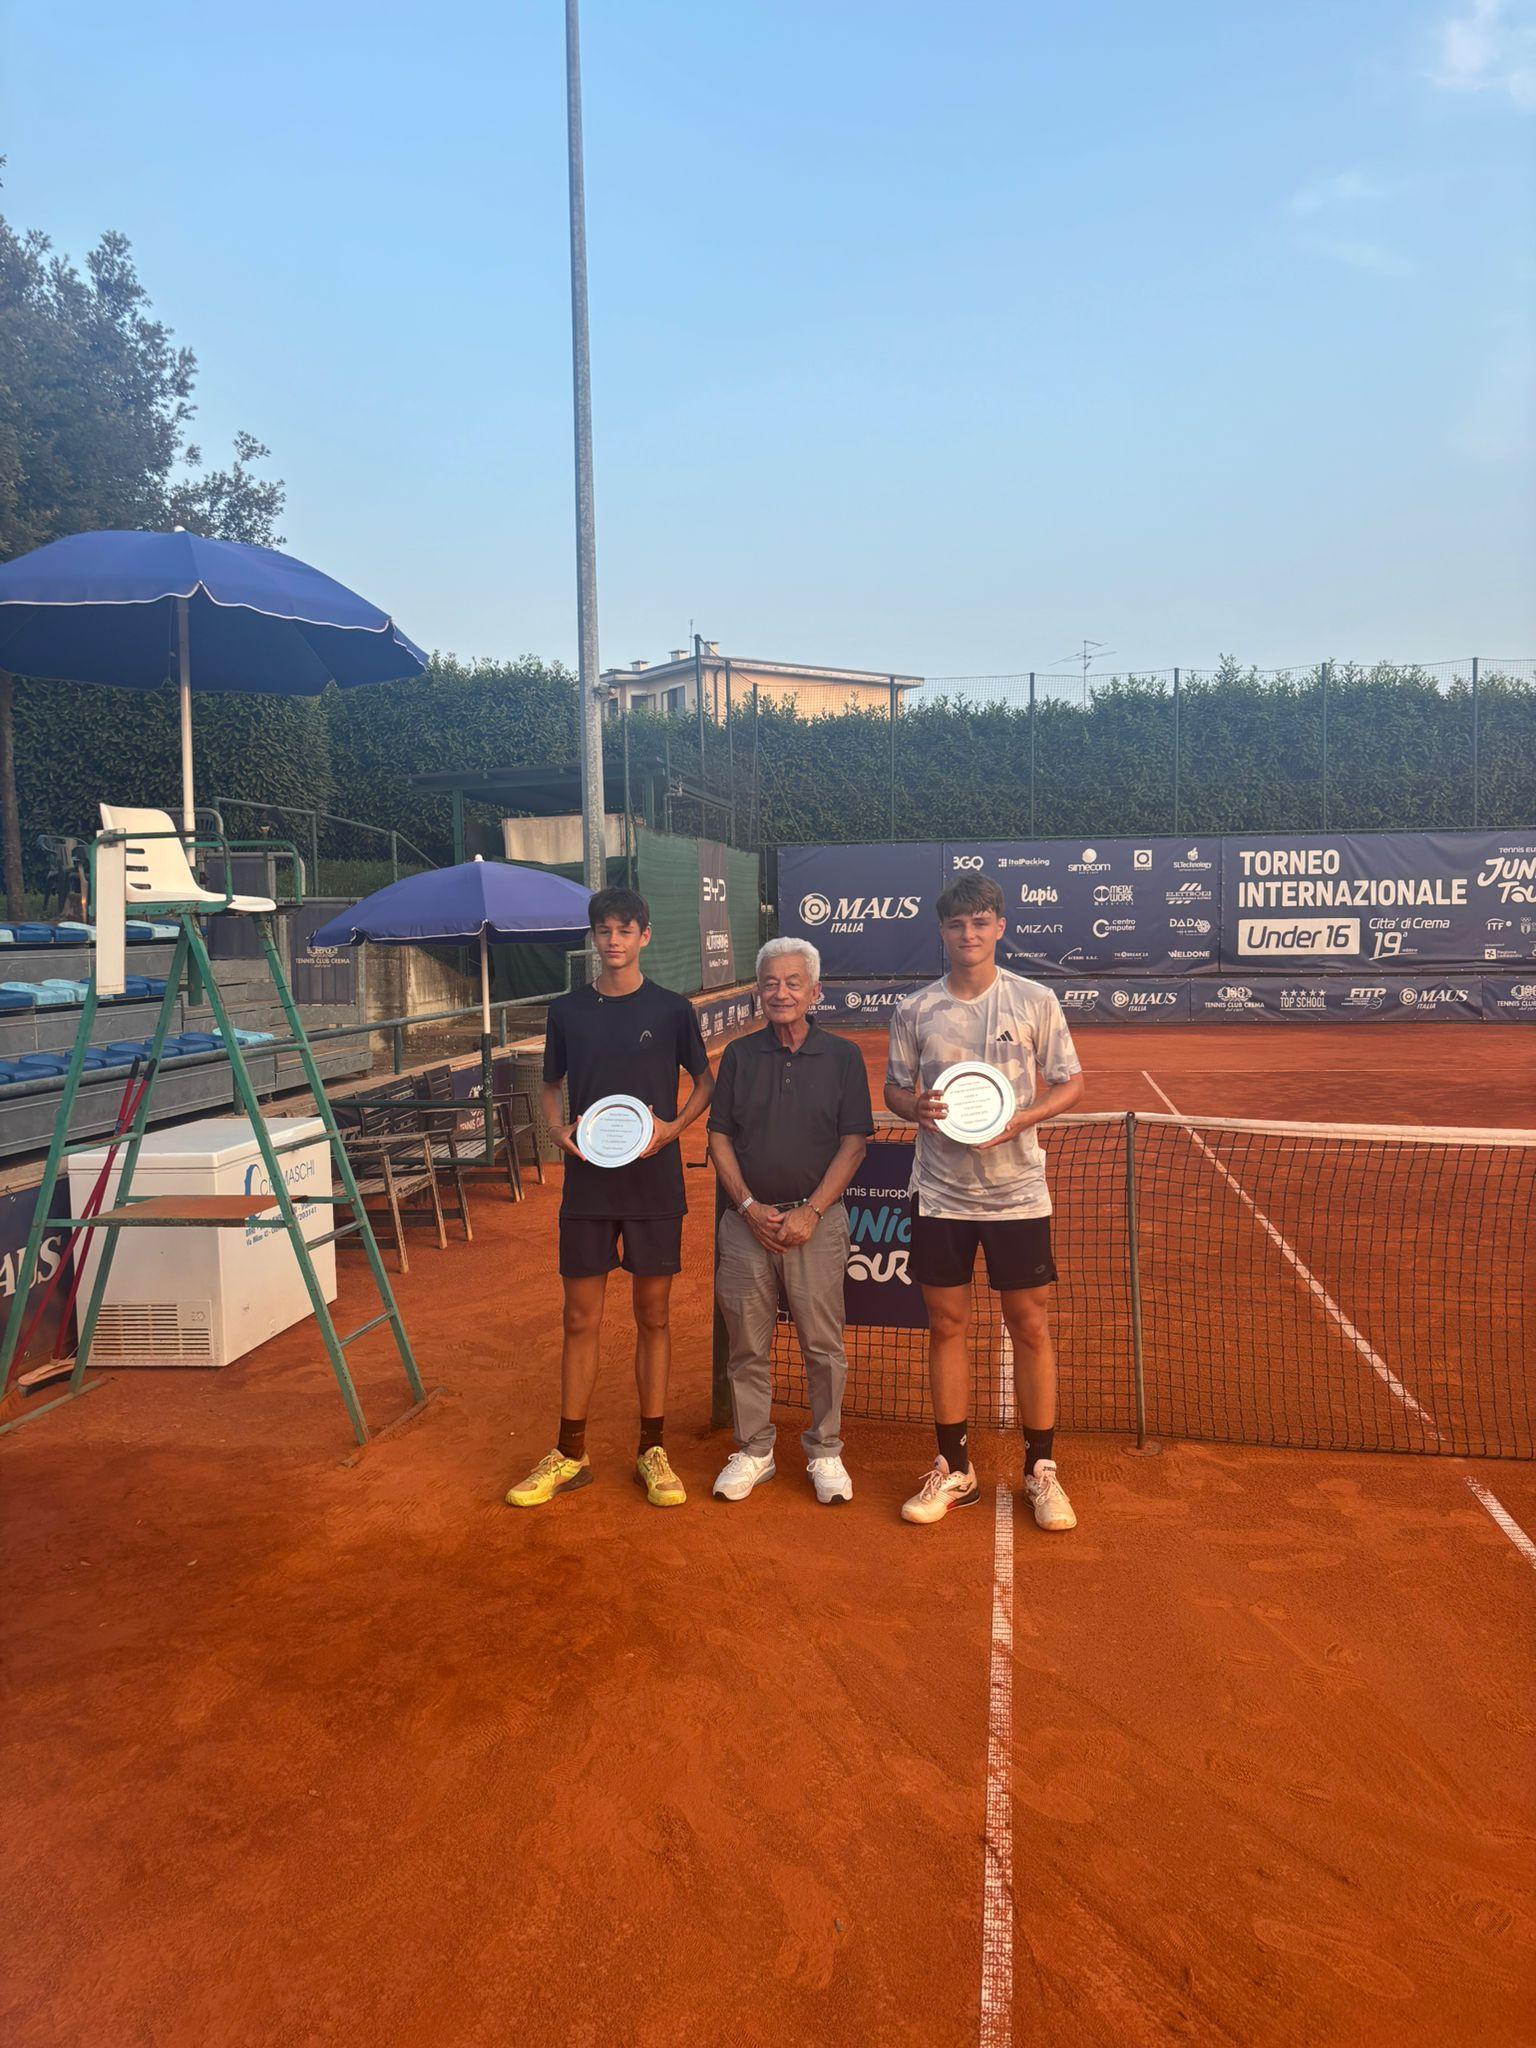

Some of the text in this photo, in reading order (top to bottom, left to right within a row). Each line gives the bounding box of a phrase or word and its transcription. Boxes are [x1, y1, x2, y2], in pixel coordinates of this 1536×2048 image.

[1009, 858, 1050, 866] ItalPacking
[1239, 849, 1340, 876] TORNEO
[1021, 884, 1058, 906] lapis
[1110, 894, 1133, 902] WORK
[1238, 879, 1468, 908] INTERNAZIONALE
[832, 896, 921, 920] MAUS
[831, 923, 863, 933] ITALIA
[1016, 924, 1063, 934] MIZAR
[1369, 917, 1450, 929] Citta' di Crema
[1247, 925, 1351, 948] Under 16
[1168, 950, 1210, 958] WELDONE
[1064, 990, 1099, 1000] FITP
[1129, 992, 1177, 1005] MAUS
[1350, 987, 1386, 998] FITP
[1418, 989, 1468, 1003] MAUS
[1280, 997, 1295, 1008] TOP
[1297, 997, 1327, 1008] SCHOOL
[260, 1160, 315, 1196] CASCHI
